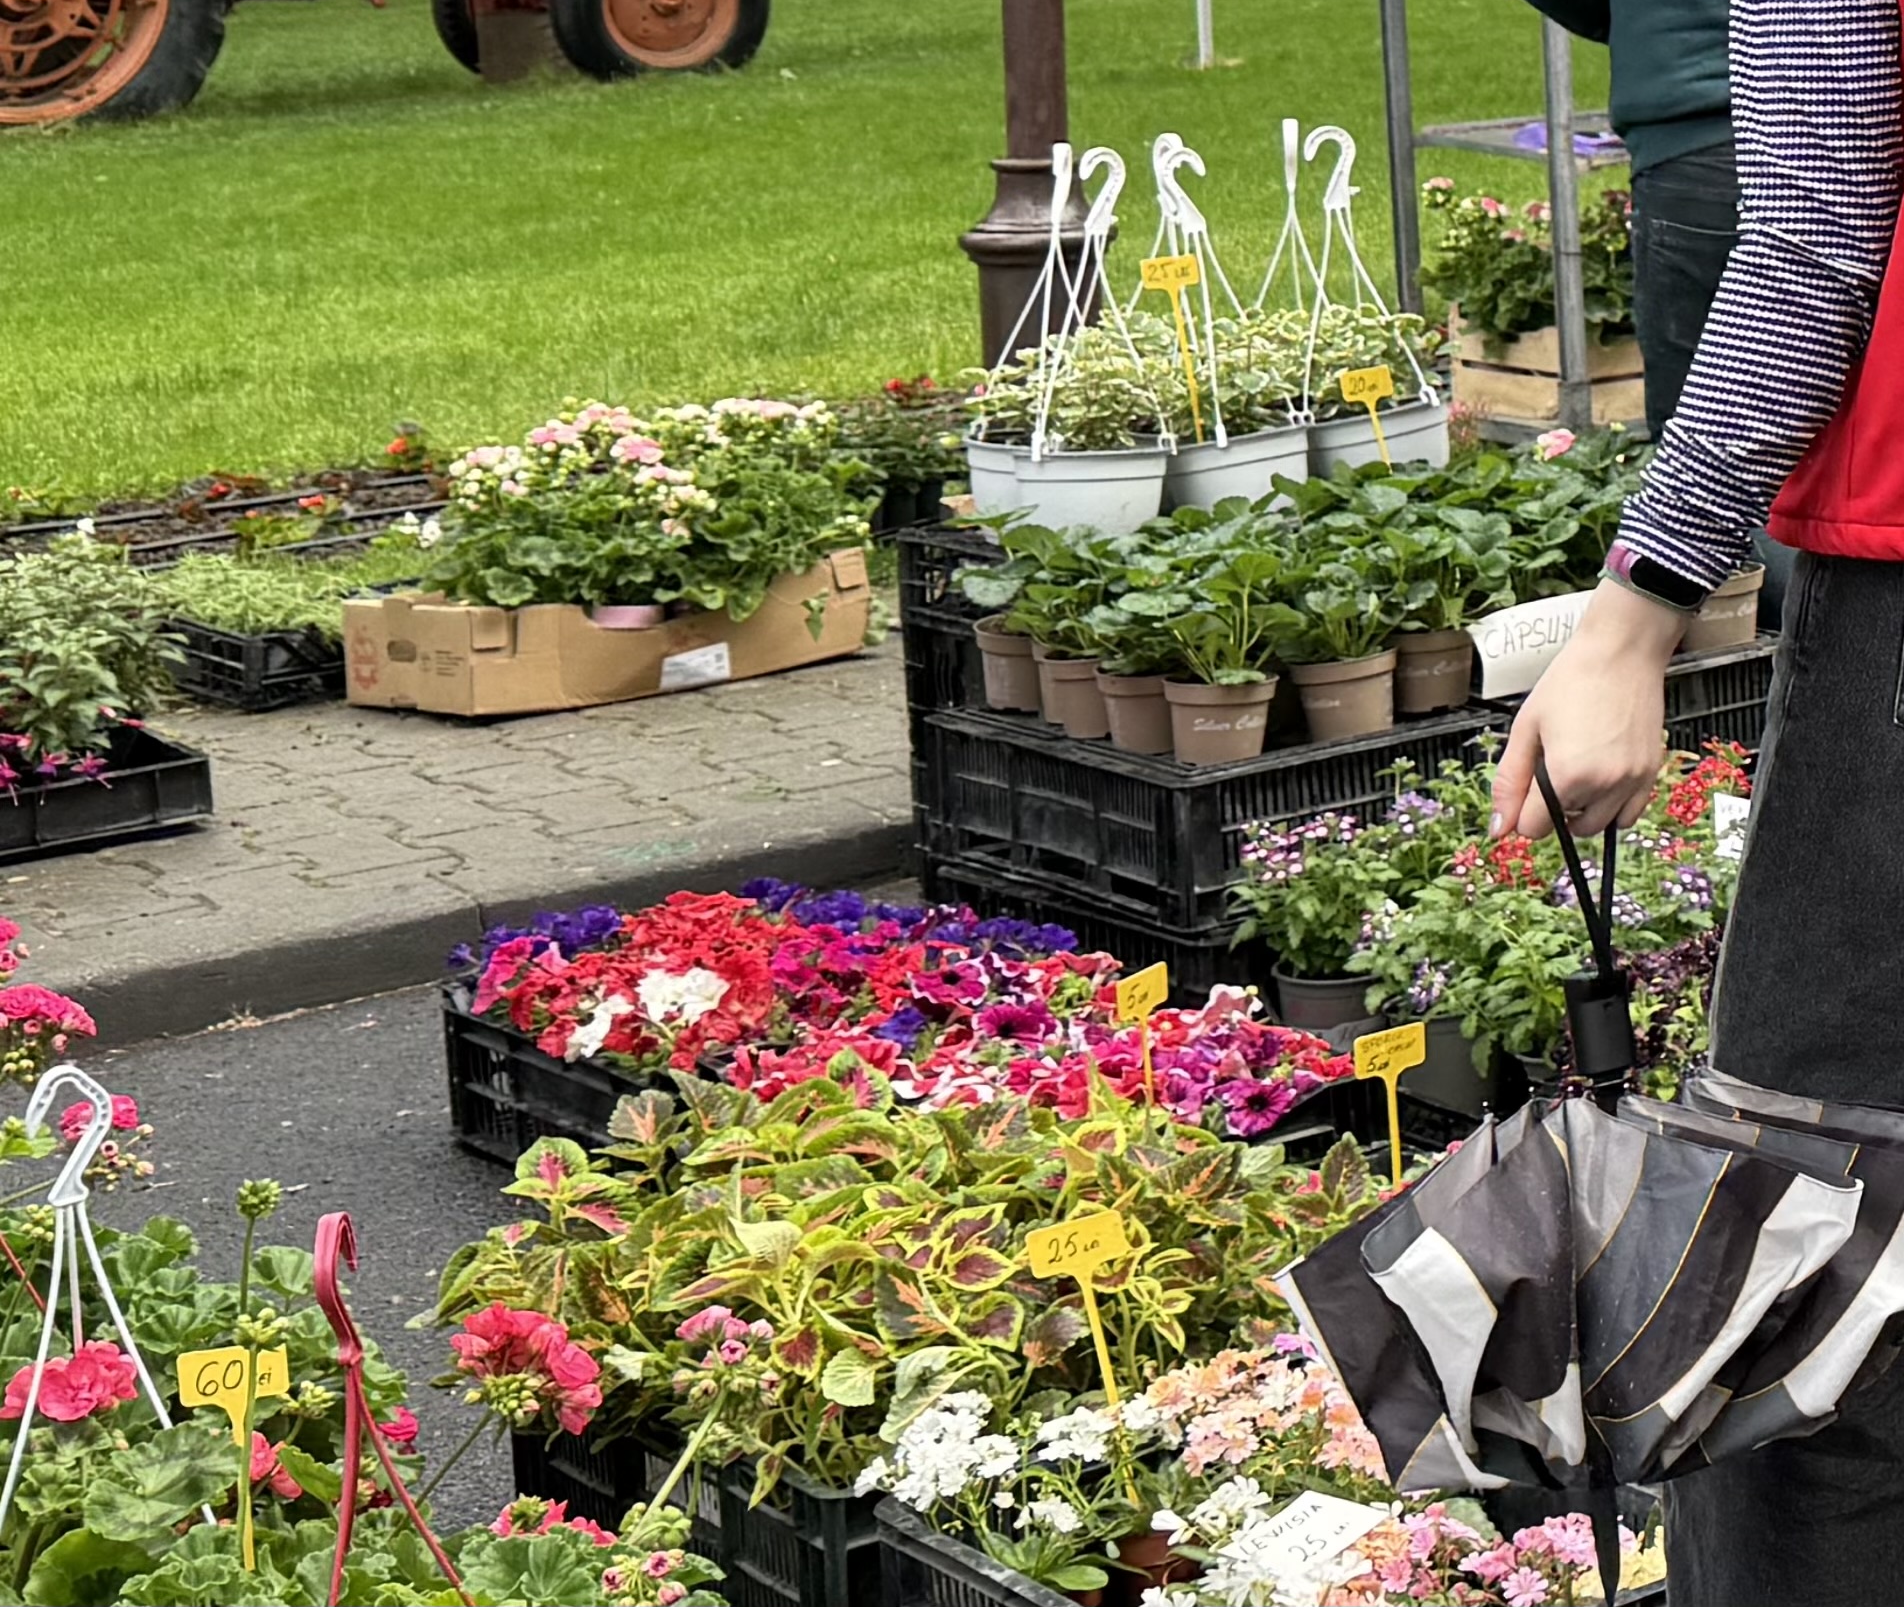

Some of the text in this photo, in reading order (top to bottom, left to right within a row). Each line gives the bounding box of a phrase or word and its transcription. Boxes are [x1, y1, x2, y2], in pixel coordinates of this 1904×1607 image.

[1047, 1231, 1079, 1265] 25
[196, 1359, 244, 1397] 60
[1239, 1503, 1323, 1556] LEWISIA
[1288, 1533, 1328, 1563] 25
